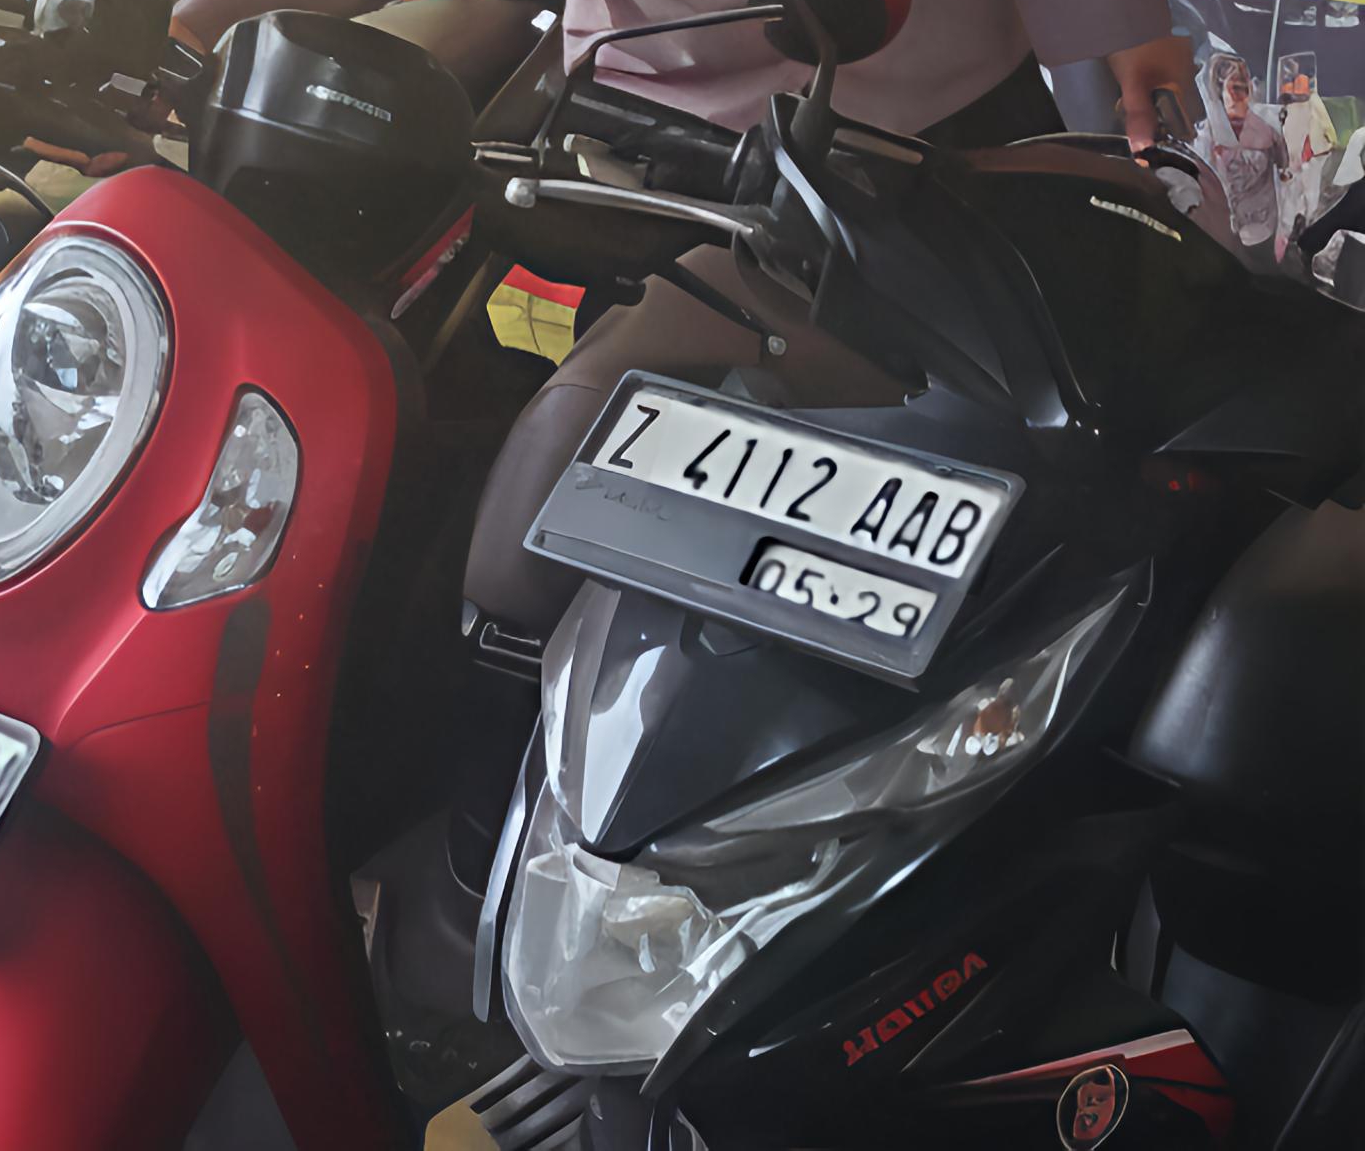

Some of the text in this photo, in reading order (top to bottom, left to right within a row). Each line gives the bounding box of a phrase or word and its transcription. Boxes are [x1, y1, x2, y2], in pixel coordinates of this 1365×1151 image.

[607, 404, 660, 469] Z
[682, 429, 838, 522] 4112
[850, 477, 982, 566] AAB
